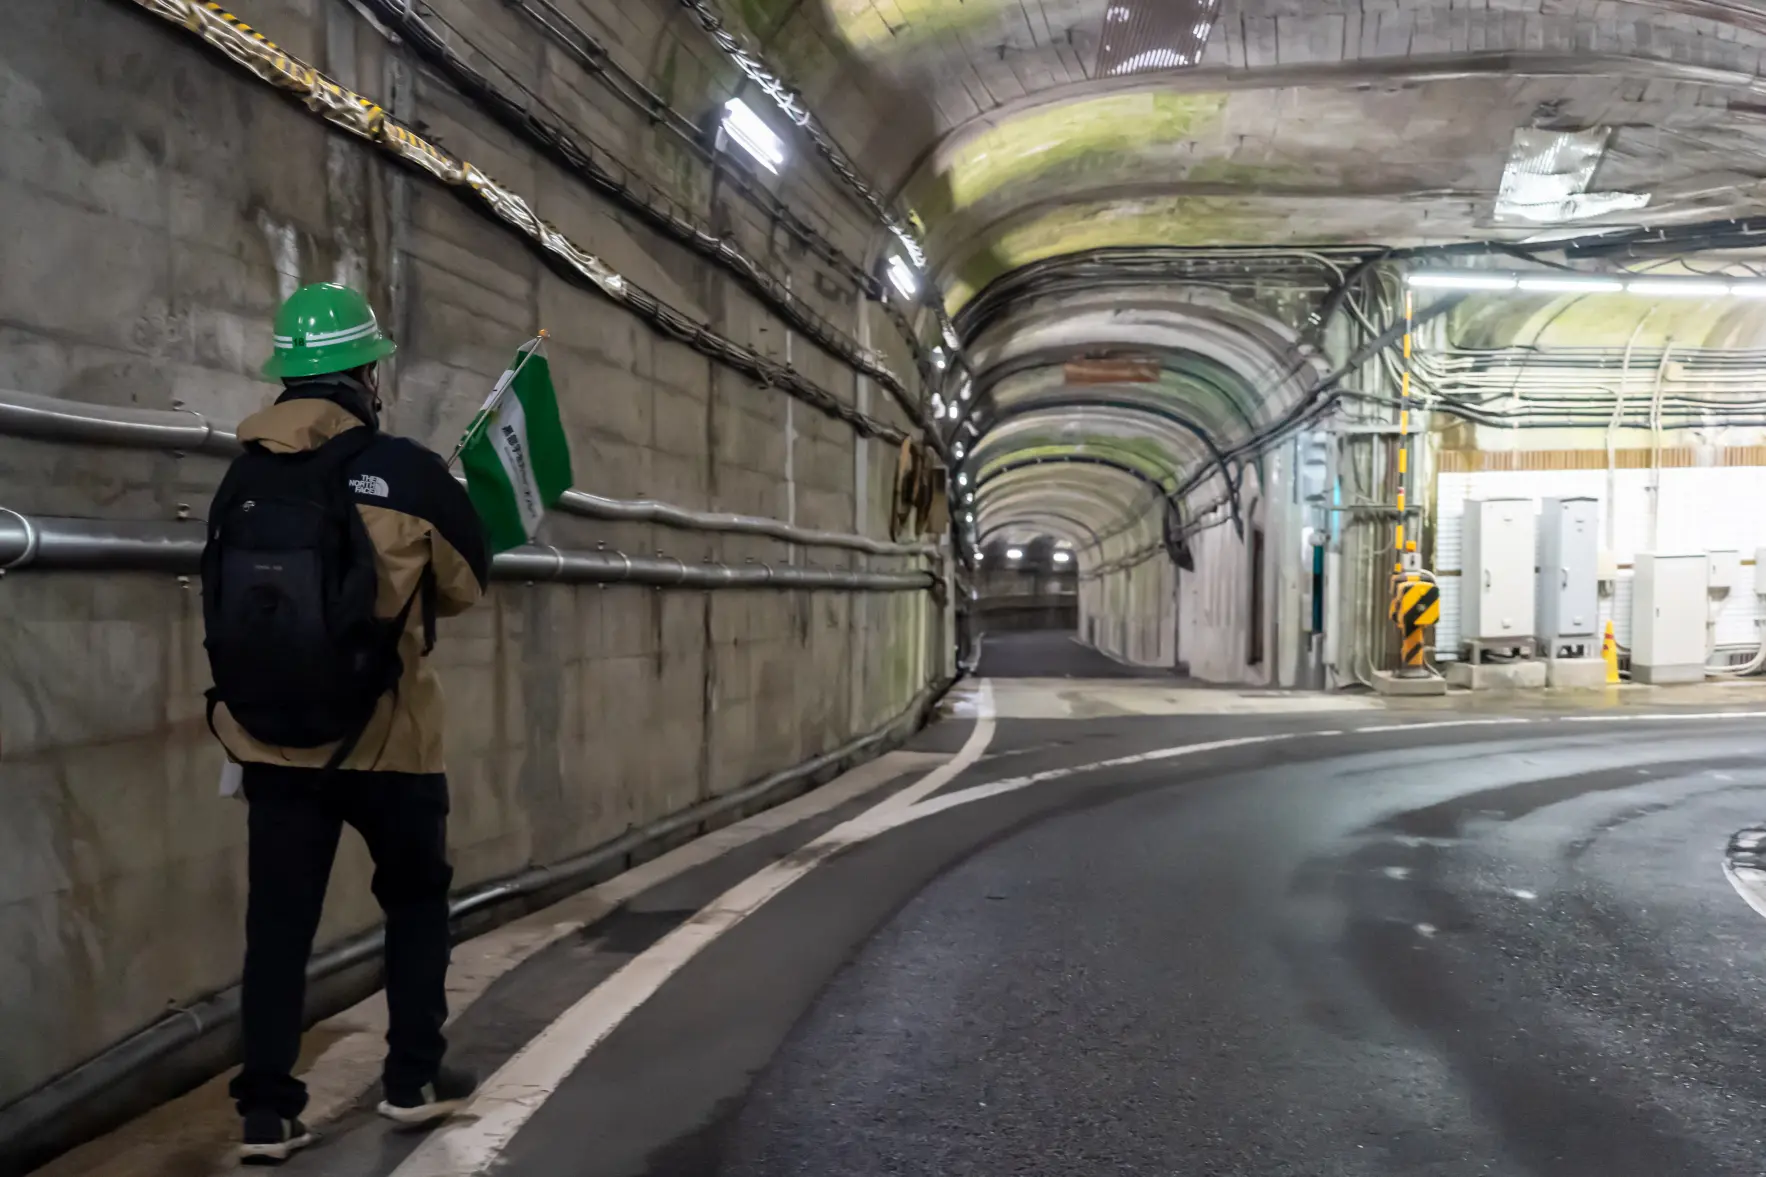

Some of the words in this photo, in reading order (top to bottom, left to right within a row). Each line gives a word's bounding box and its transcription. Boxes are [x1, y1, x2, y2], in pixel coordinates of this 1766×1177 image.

[293, 338, 305, 347] 18
[361, 474, 377, 483] THE
[348, 479, 377, 489] NORTH
[354, 486, 375, 495] FACE
